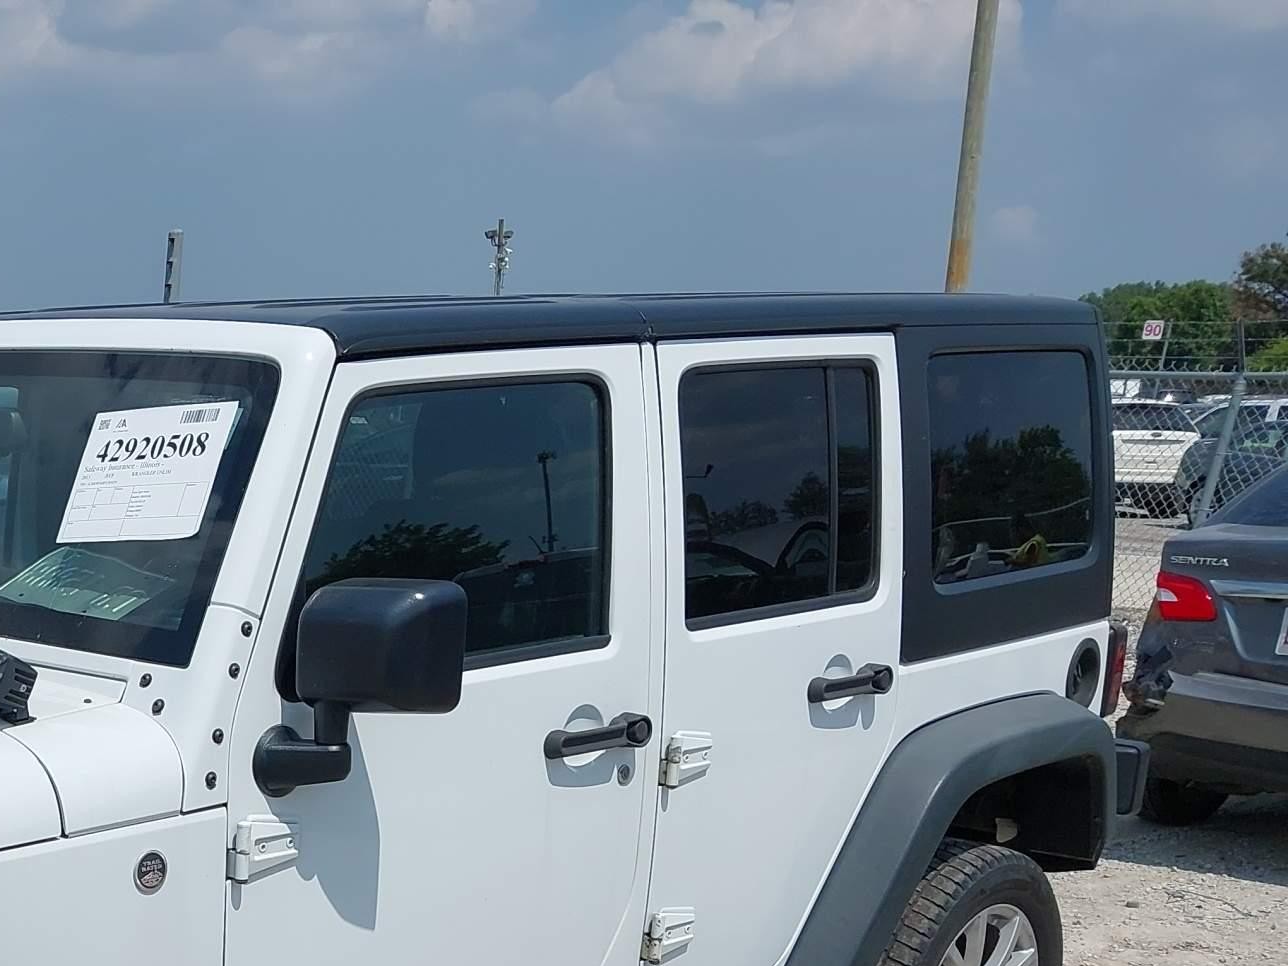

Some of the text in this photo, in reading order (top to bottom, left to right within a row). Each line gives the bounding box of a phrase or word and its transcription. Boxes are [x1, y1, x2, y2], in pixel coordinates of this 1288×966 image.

[1143, 324, 1162, 337] 90
[96, 432, 210, 463] 42920508
[1170, 555, 1230, 567] SENTRA
